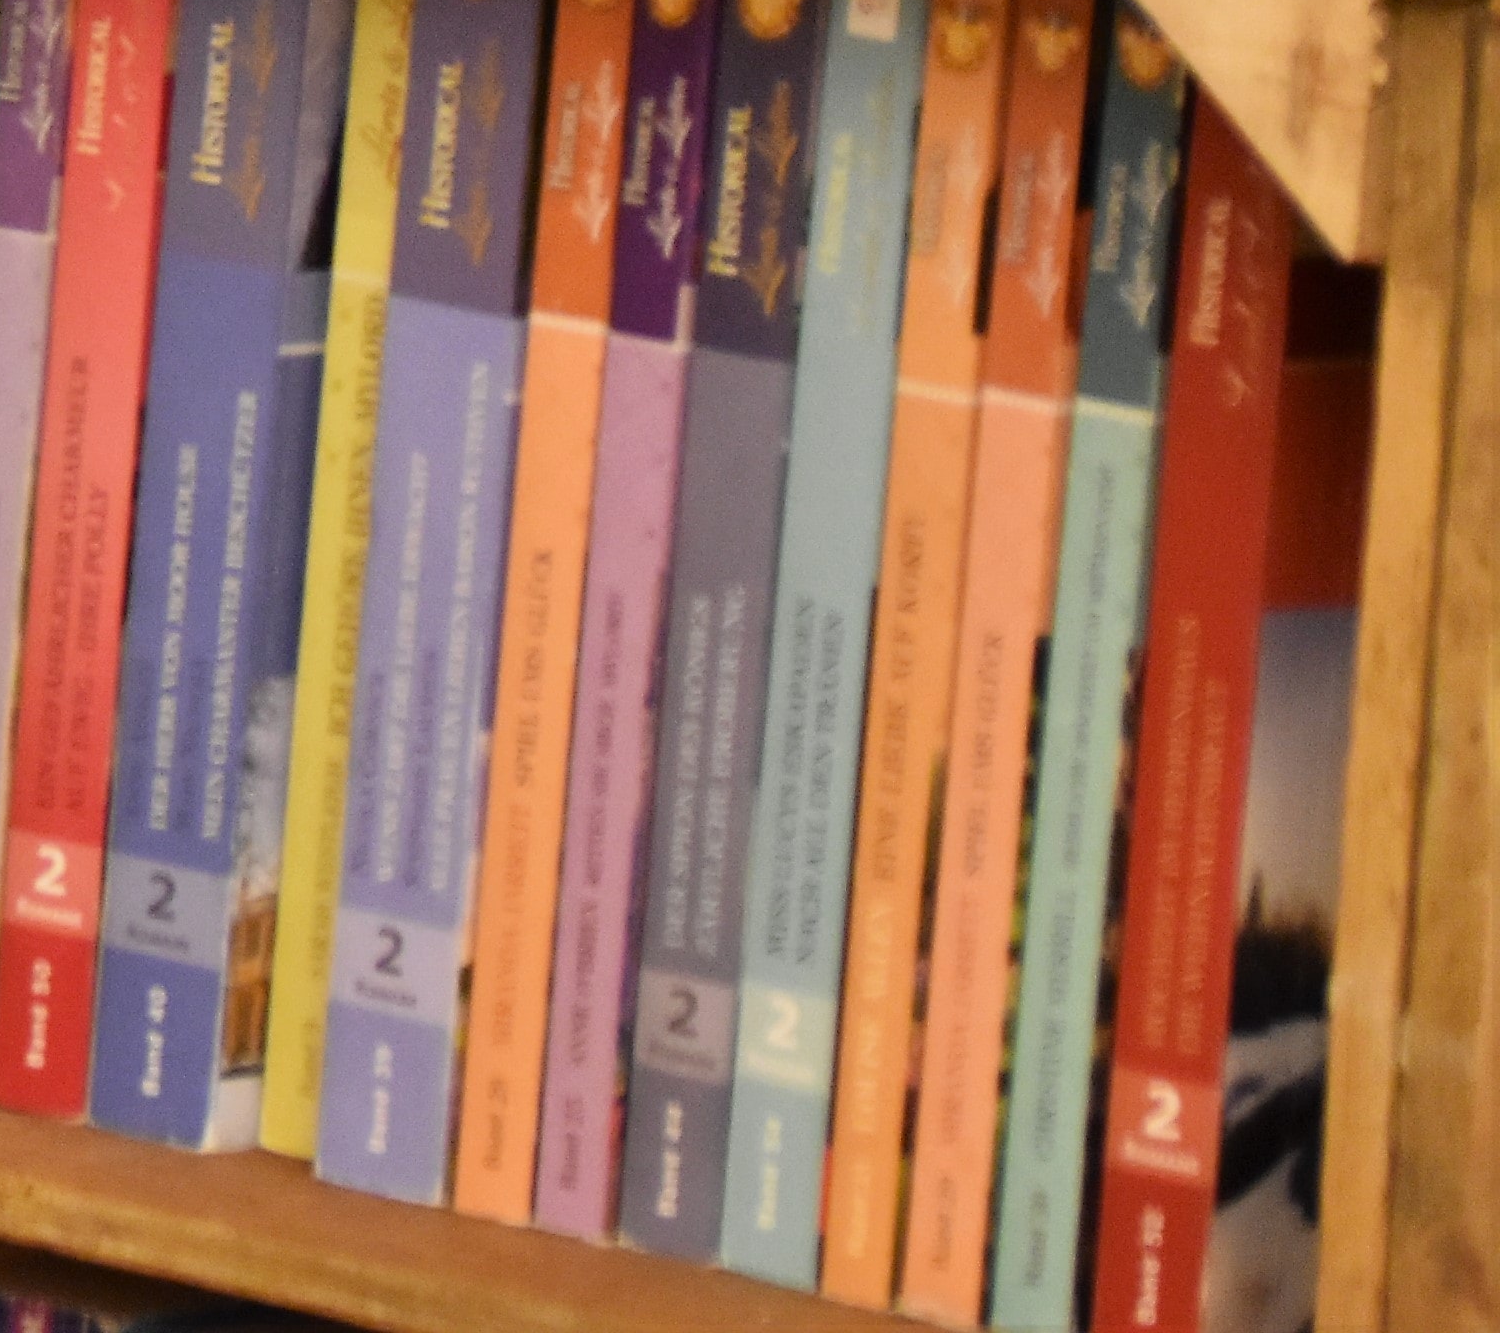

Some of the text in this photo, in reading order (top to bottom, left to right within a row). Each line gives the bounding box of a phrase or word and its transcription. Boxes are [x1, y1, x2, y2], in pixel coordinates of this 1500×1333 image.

[33, 846, 67, 897] 2
[146, 874, 176, 923] 2
[374, 930, 404, 979] 2
[1145, 1078, 1182, 1143] 2
